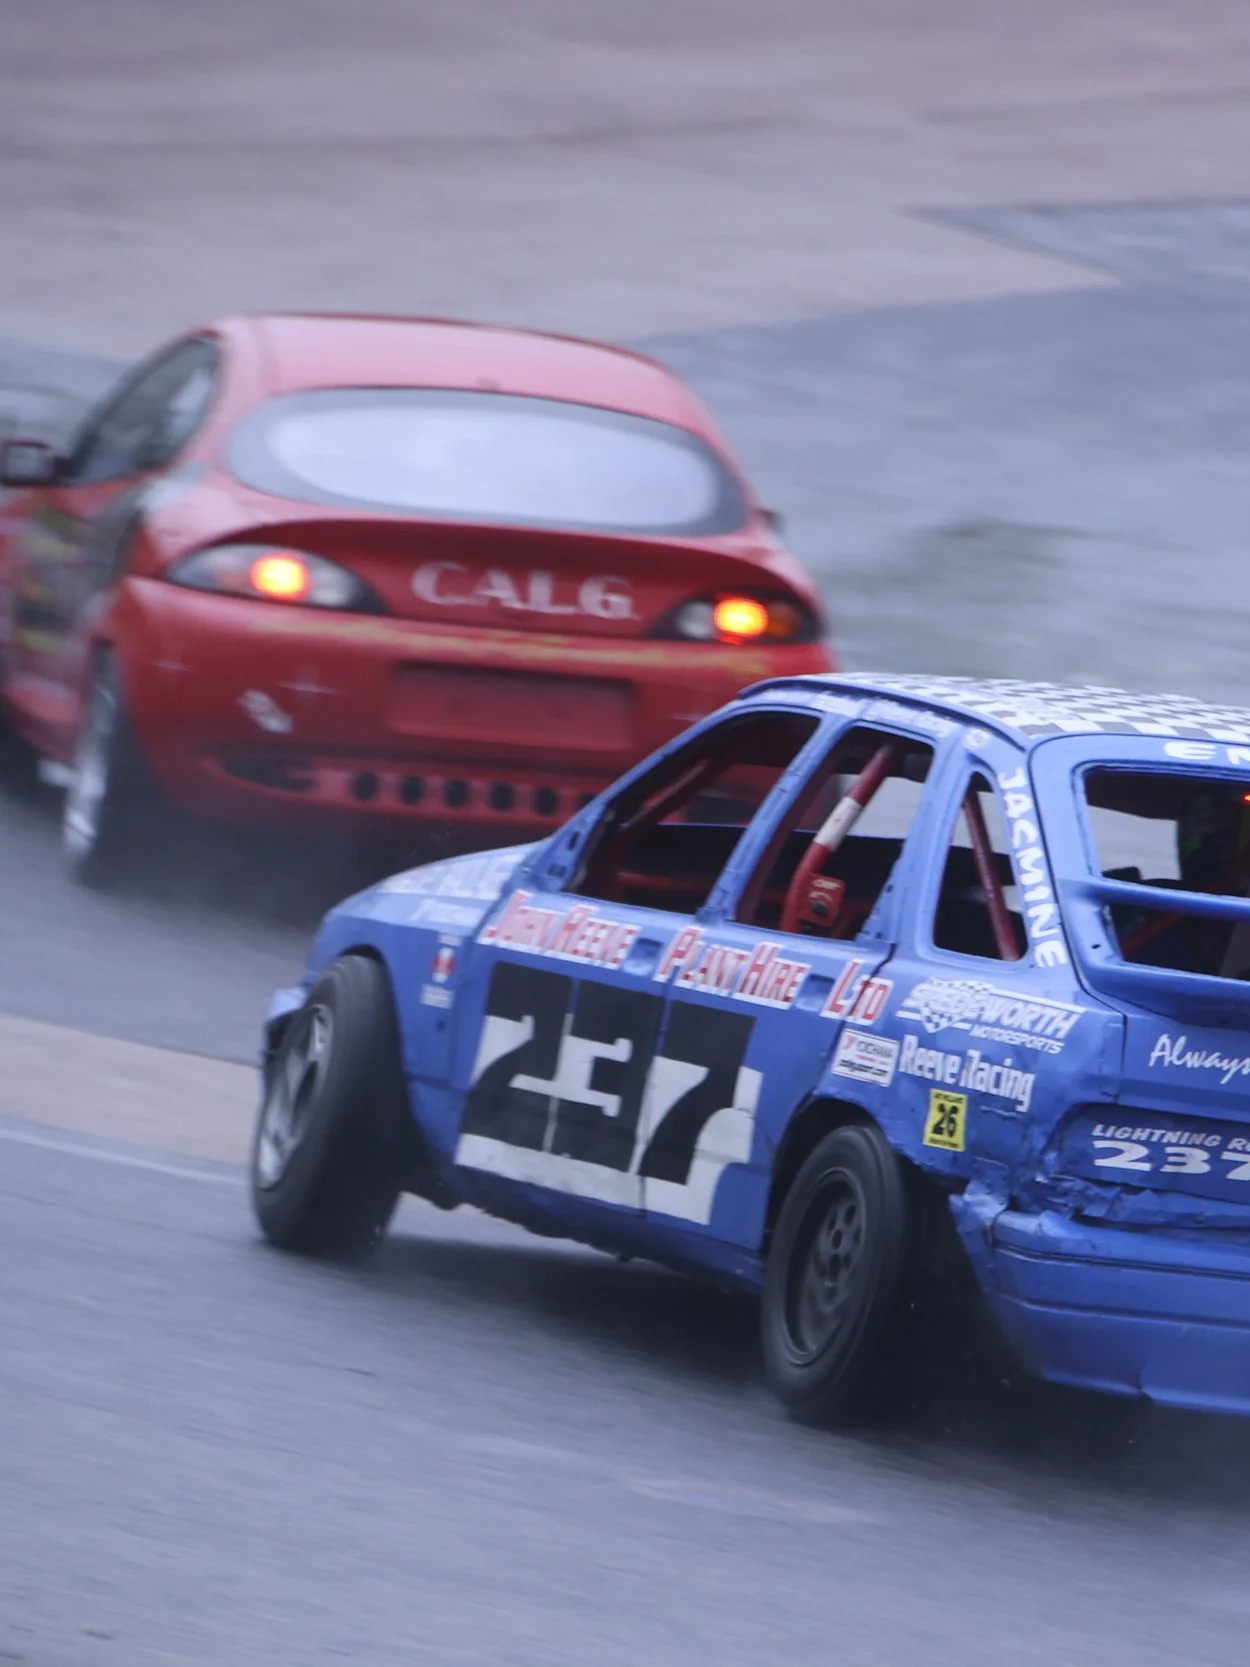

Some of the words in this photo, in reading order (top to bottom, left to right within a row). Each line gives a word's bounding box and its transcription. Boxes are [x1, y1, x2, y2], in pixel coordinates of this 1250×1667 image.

[998, 767, 1067, 968] JASMINE
[733, 942, 810, 1010] HIRE
[968, 1023, 1065, 1055] MOTORSPORTS
[460, 961, 756, 1187] 237
[899, 1034, 961, 1084] Reeve
[958, 1049, 1036, 1113] Racing
[931, 1103, 960, 1138] 26
[1092, 1124, 1222, 1148] LIGHTNING
